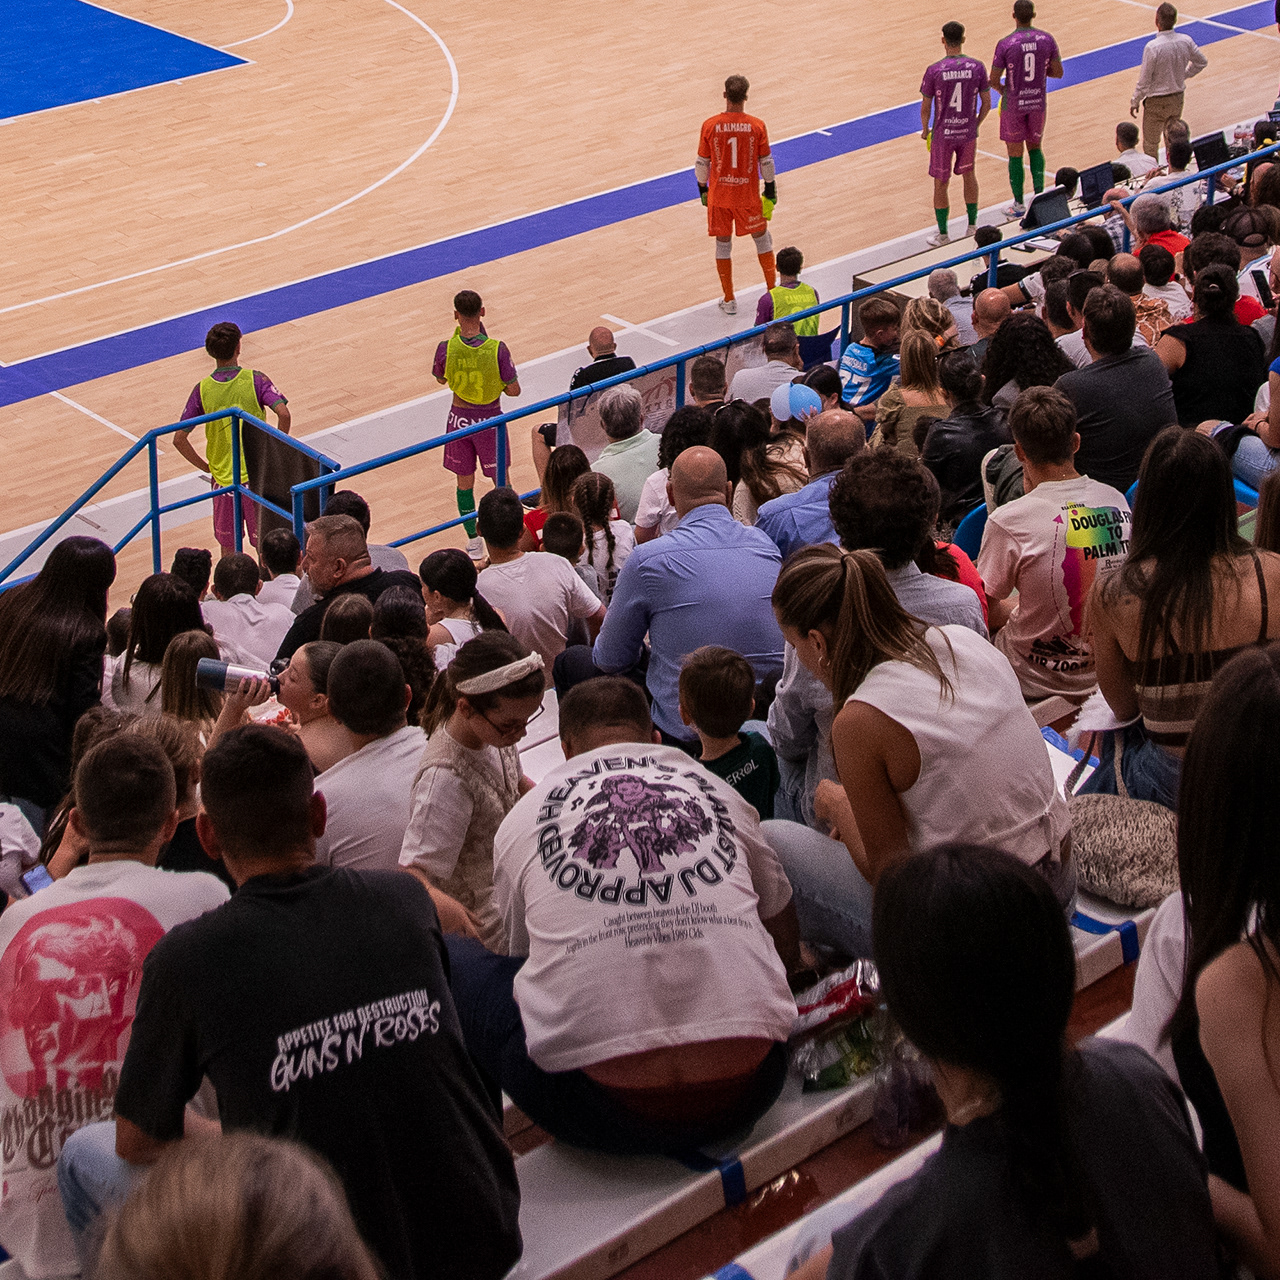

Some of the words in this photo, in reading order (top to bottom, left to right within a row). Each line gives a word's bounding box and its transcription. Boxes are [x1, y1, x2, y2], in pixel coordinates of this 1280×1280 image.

[942, 70, 973, 80] BARRANCO
[1024, 52, 1036, 82] 9
[949, 82, 962, 113] 4
[724, 123, 751, 133] ALMAGRO
[727, 136, 738, 169] 1
[1071, 511, 1124, 531] DOUGLAS
[1107, 525, 1122, 540] TO
[1083, 542, 1118, 560] PALM
[725, 759, 759, 787] ERROL
[537, 822, 675, 907] APPROVED
[678, 855, 723, 898] DJ
[277, 1018, 333, 1054] APPETITE
[333, 1008, 357, 1033] FOR
[356, 988, 429, 1024] DESTRUCTION
[270, 1030, 342, 1092] GUNS
[374, 1000, 441, 1048] ROSES
